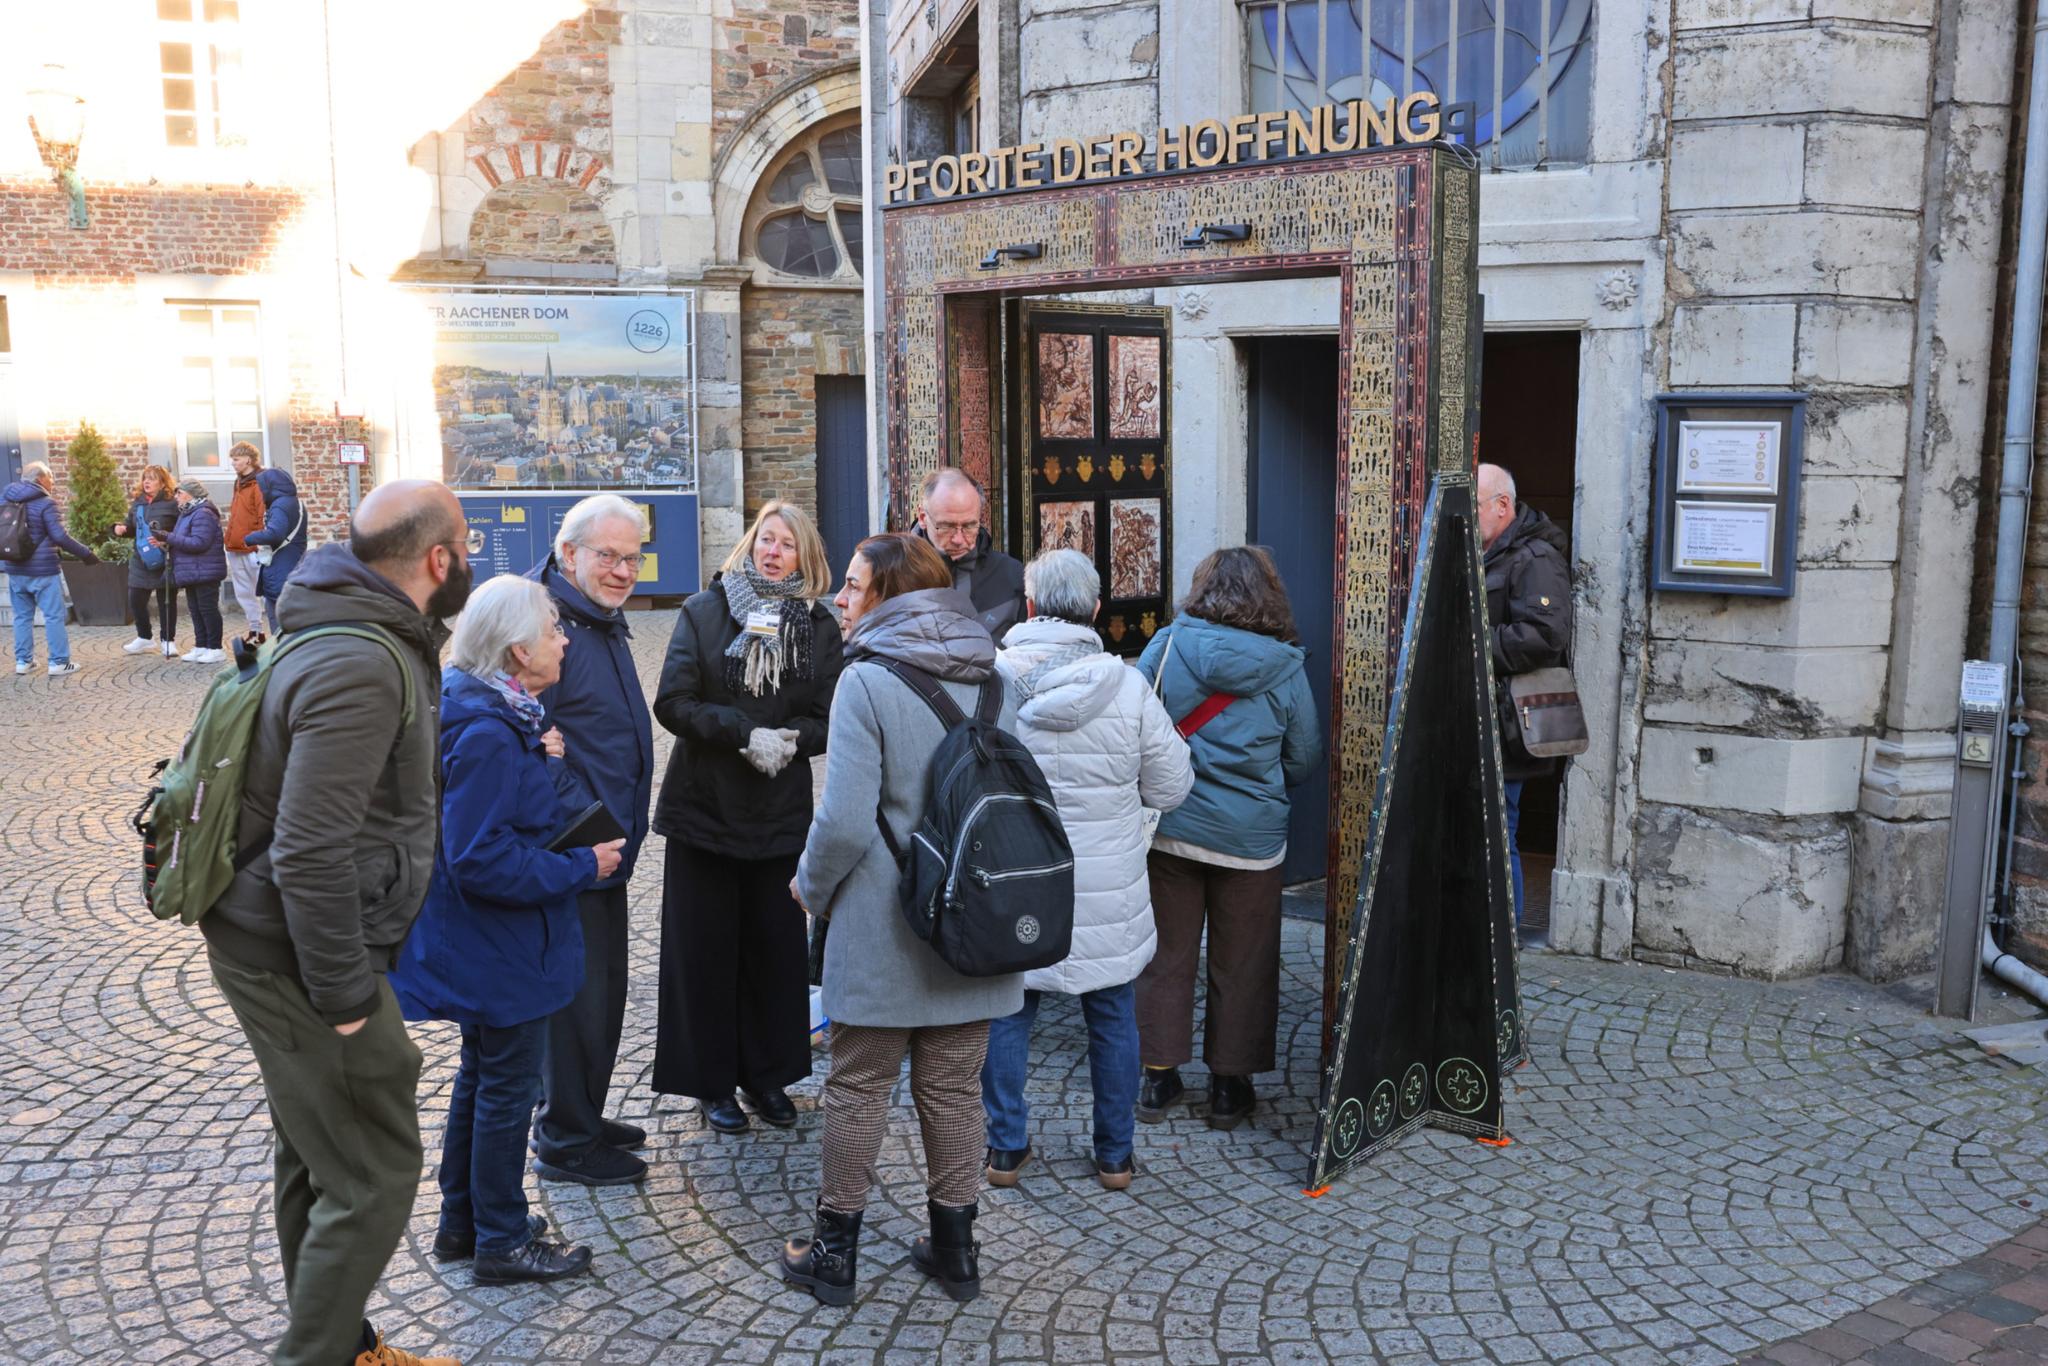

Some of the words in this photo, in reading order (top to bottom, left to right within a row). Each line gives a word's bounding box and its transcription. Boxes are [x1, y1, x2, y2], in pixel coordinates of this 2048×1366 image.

[884, 143, 1044, 204] PFORTE
[1054, 131, 1145, 183] DER
[1157, 91, 1442, 173] HOFFNUNG
[449, 306, 530, 319] AACHENER
[533, 307, 569, 319] DOM
[633, 322, 663, 337] 1226
